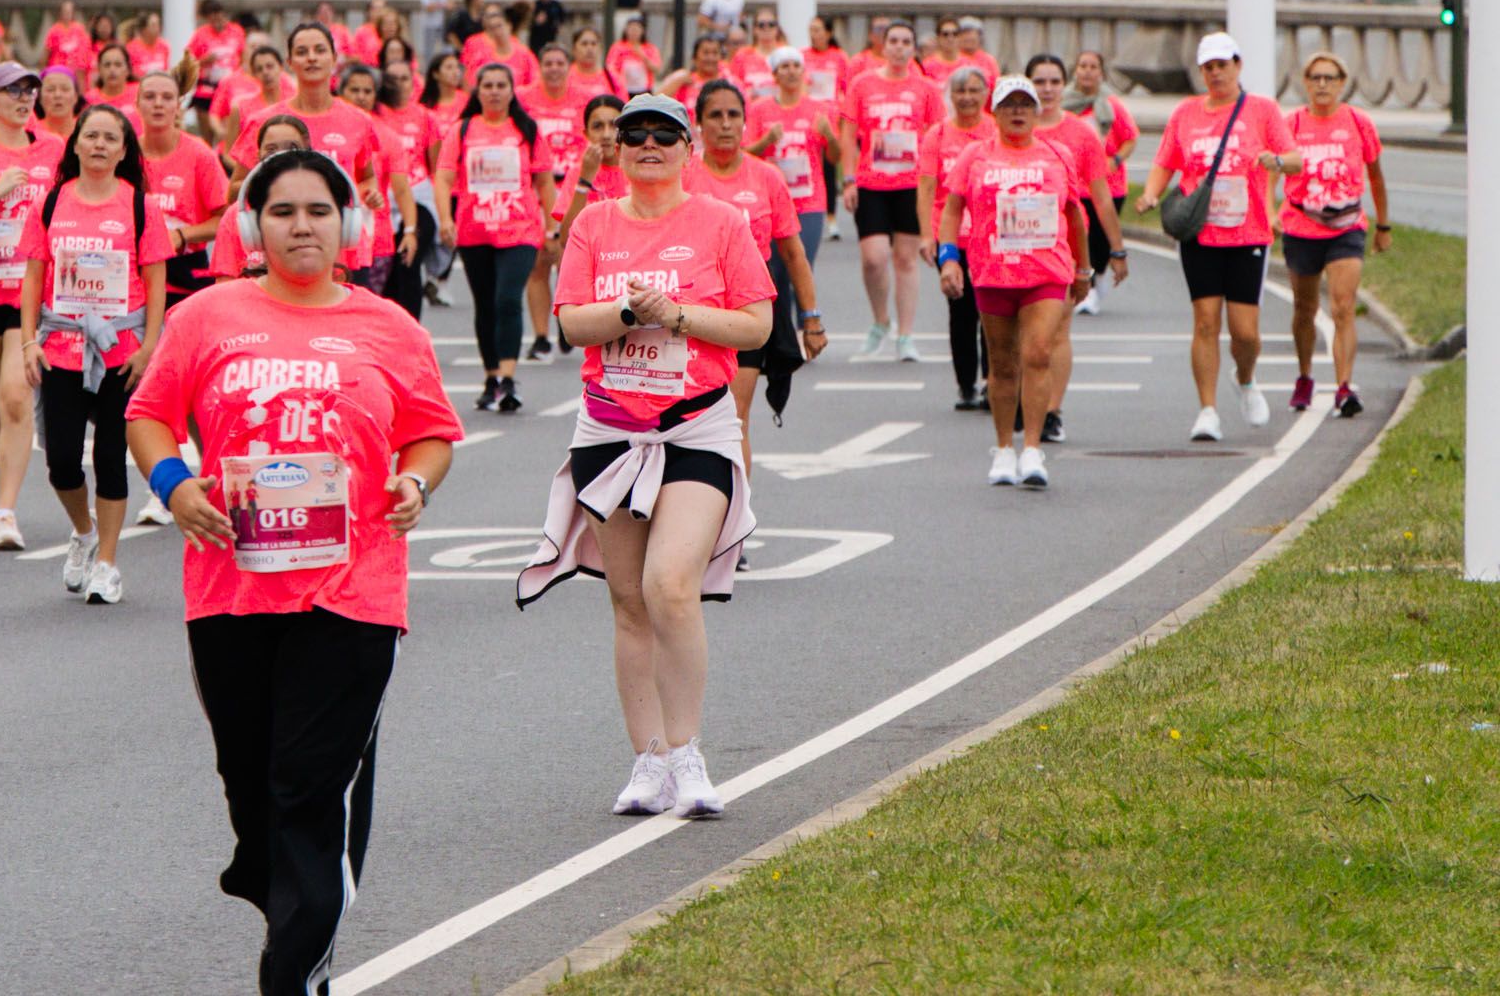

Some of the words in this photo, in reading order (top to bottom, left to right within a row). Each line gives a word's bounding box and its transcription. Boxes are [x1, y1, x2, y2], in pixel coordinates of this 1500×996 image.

[600, 251, 629, 262] YSHO
[77, 279, 105, 291] 016
[220, 332, 269, 352] OYSHO
[625, 343, 658, 360] 016
[222, 358, 341, 394] CARRERA
[259, 507, 308, 529] 016
